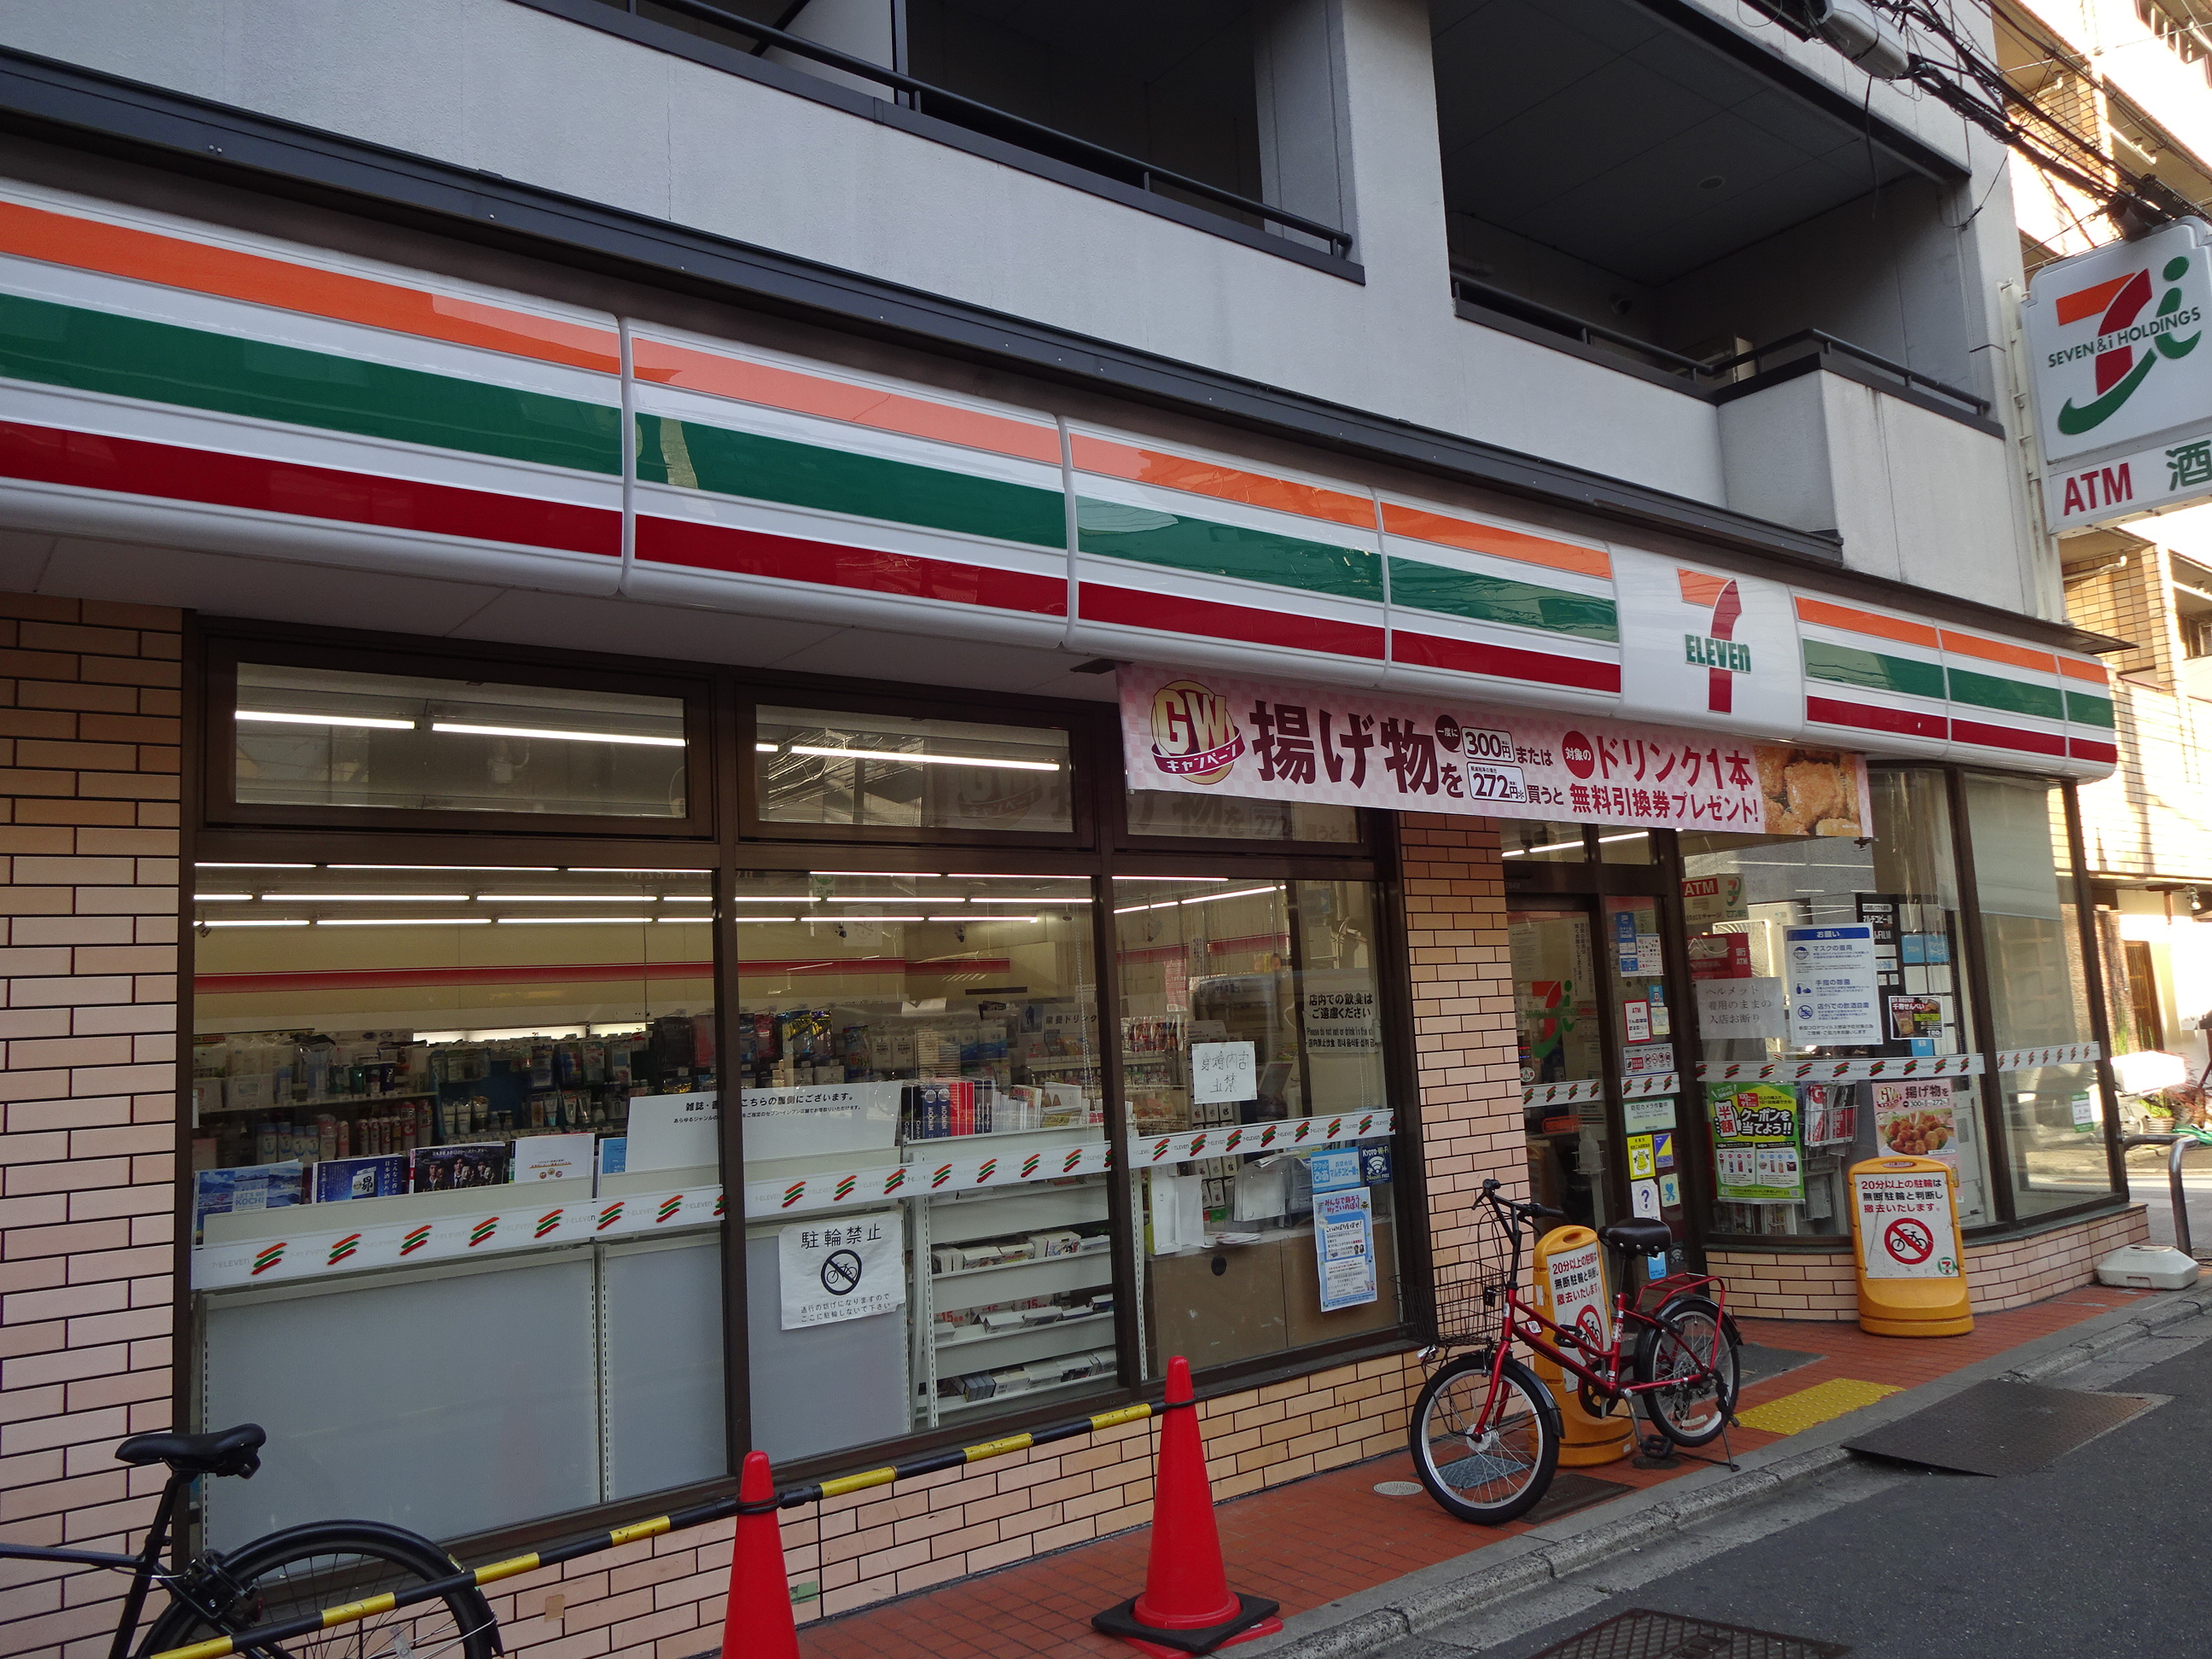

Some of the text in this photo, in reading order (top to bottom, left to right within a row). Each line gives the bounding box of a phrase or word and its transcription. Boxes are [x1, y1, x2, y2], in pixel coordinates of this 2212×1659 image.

[2117, 306, 2201, 345] HOLDINGS
[2165, 439, 2212, 492] 酒
[2064, 462, 2133, 516] ATM
[1154, 687, 1227, 755] GW
[1166, 745, 1239, 774] キャンペーン
[1515, 746, 1553, 766] または
[1564, 745, 1592, 765] 対象の
[1526, 784, 1566, 806] 買うと
[1685, 882, 1715, 895] ATM
[1309, 992, 1373, 1006] 店内での飲食は
[1706, 985, 1758, 996] ヘルメット
[1312, 1007, 1371, 1019] ご遠慮ください
[1708, 999, 1772, 1010] 着用のままの
[1708, 1014, 1760, 1025] 入店お断り
[1719, 1106, 1734, 1133] 半額
[1741, 1109, 1790, 1122] クーポンを
[1362, 1149, 1377, 1157] KYOTO
[1861, 1179, 1941, 1190] 20分以上の駐輪は
[236, 1196, 265, 1206] KOCHI
[1862, 1190, 1943, 1202] 無断駐輪と判断し
[800, 1223, 882, 1249] 駐輪禁止
[1551, 1252, 1598, 1275] 20分以上の駐輪は
[1554, 1267, 1598, 1289] 無断駐輪と判断し
[800, 1293, 890, 1314] 通行の妨げになりますので
[801, 1303, 891, 1323] ここに駐輪しないで下さい
